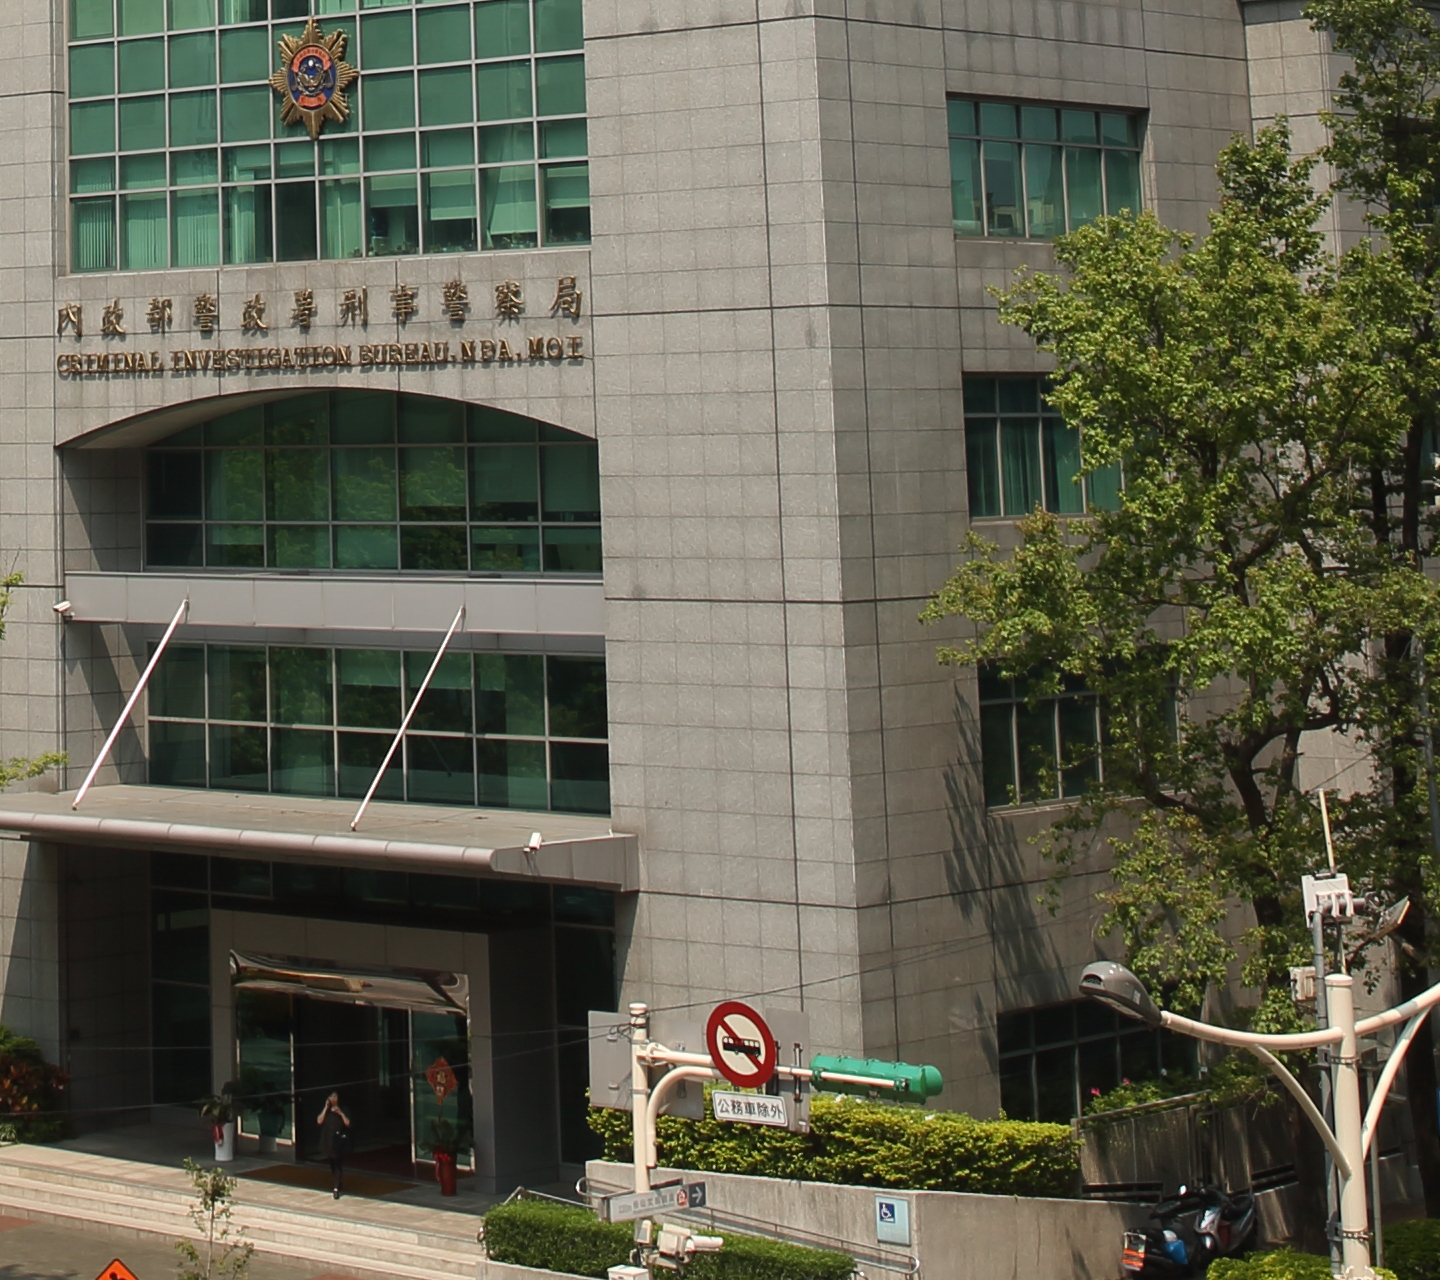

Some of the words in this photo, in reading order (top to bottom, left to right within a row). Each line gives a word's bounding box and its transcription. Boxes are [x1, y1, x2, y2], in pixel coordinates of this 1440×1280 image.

[57, 350, 164, 373] CRIMINAL
[170, 344, 351, 370] INVESTIGATION
[718, 1099, 782, 1119] 公務車除外
